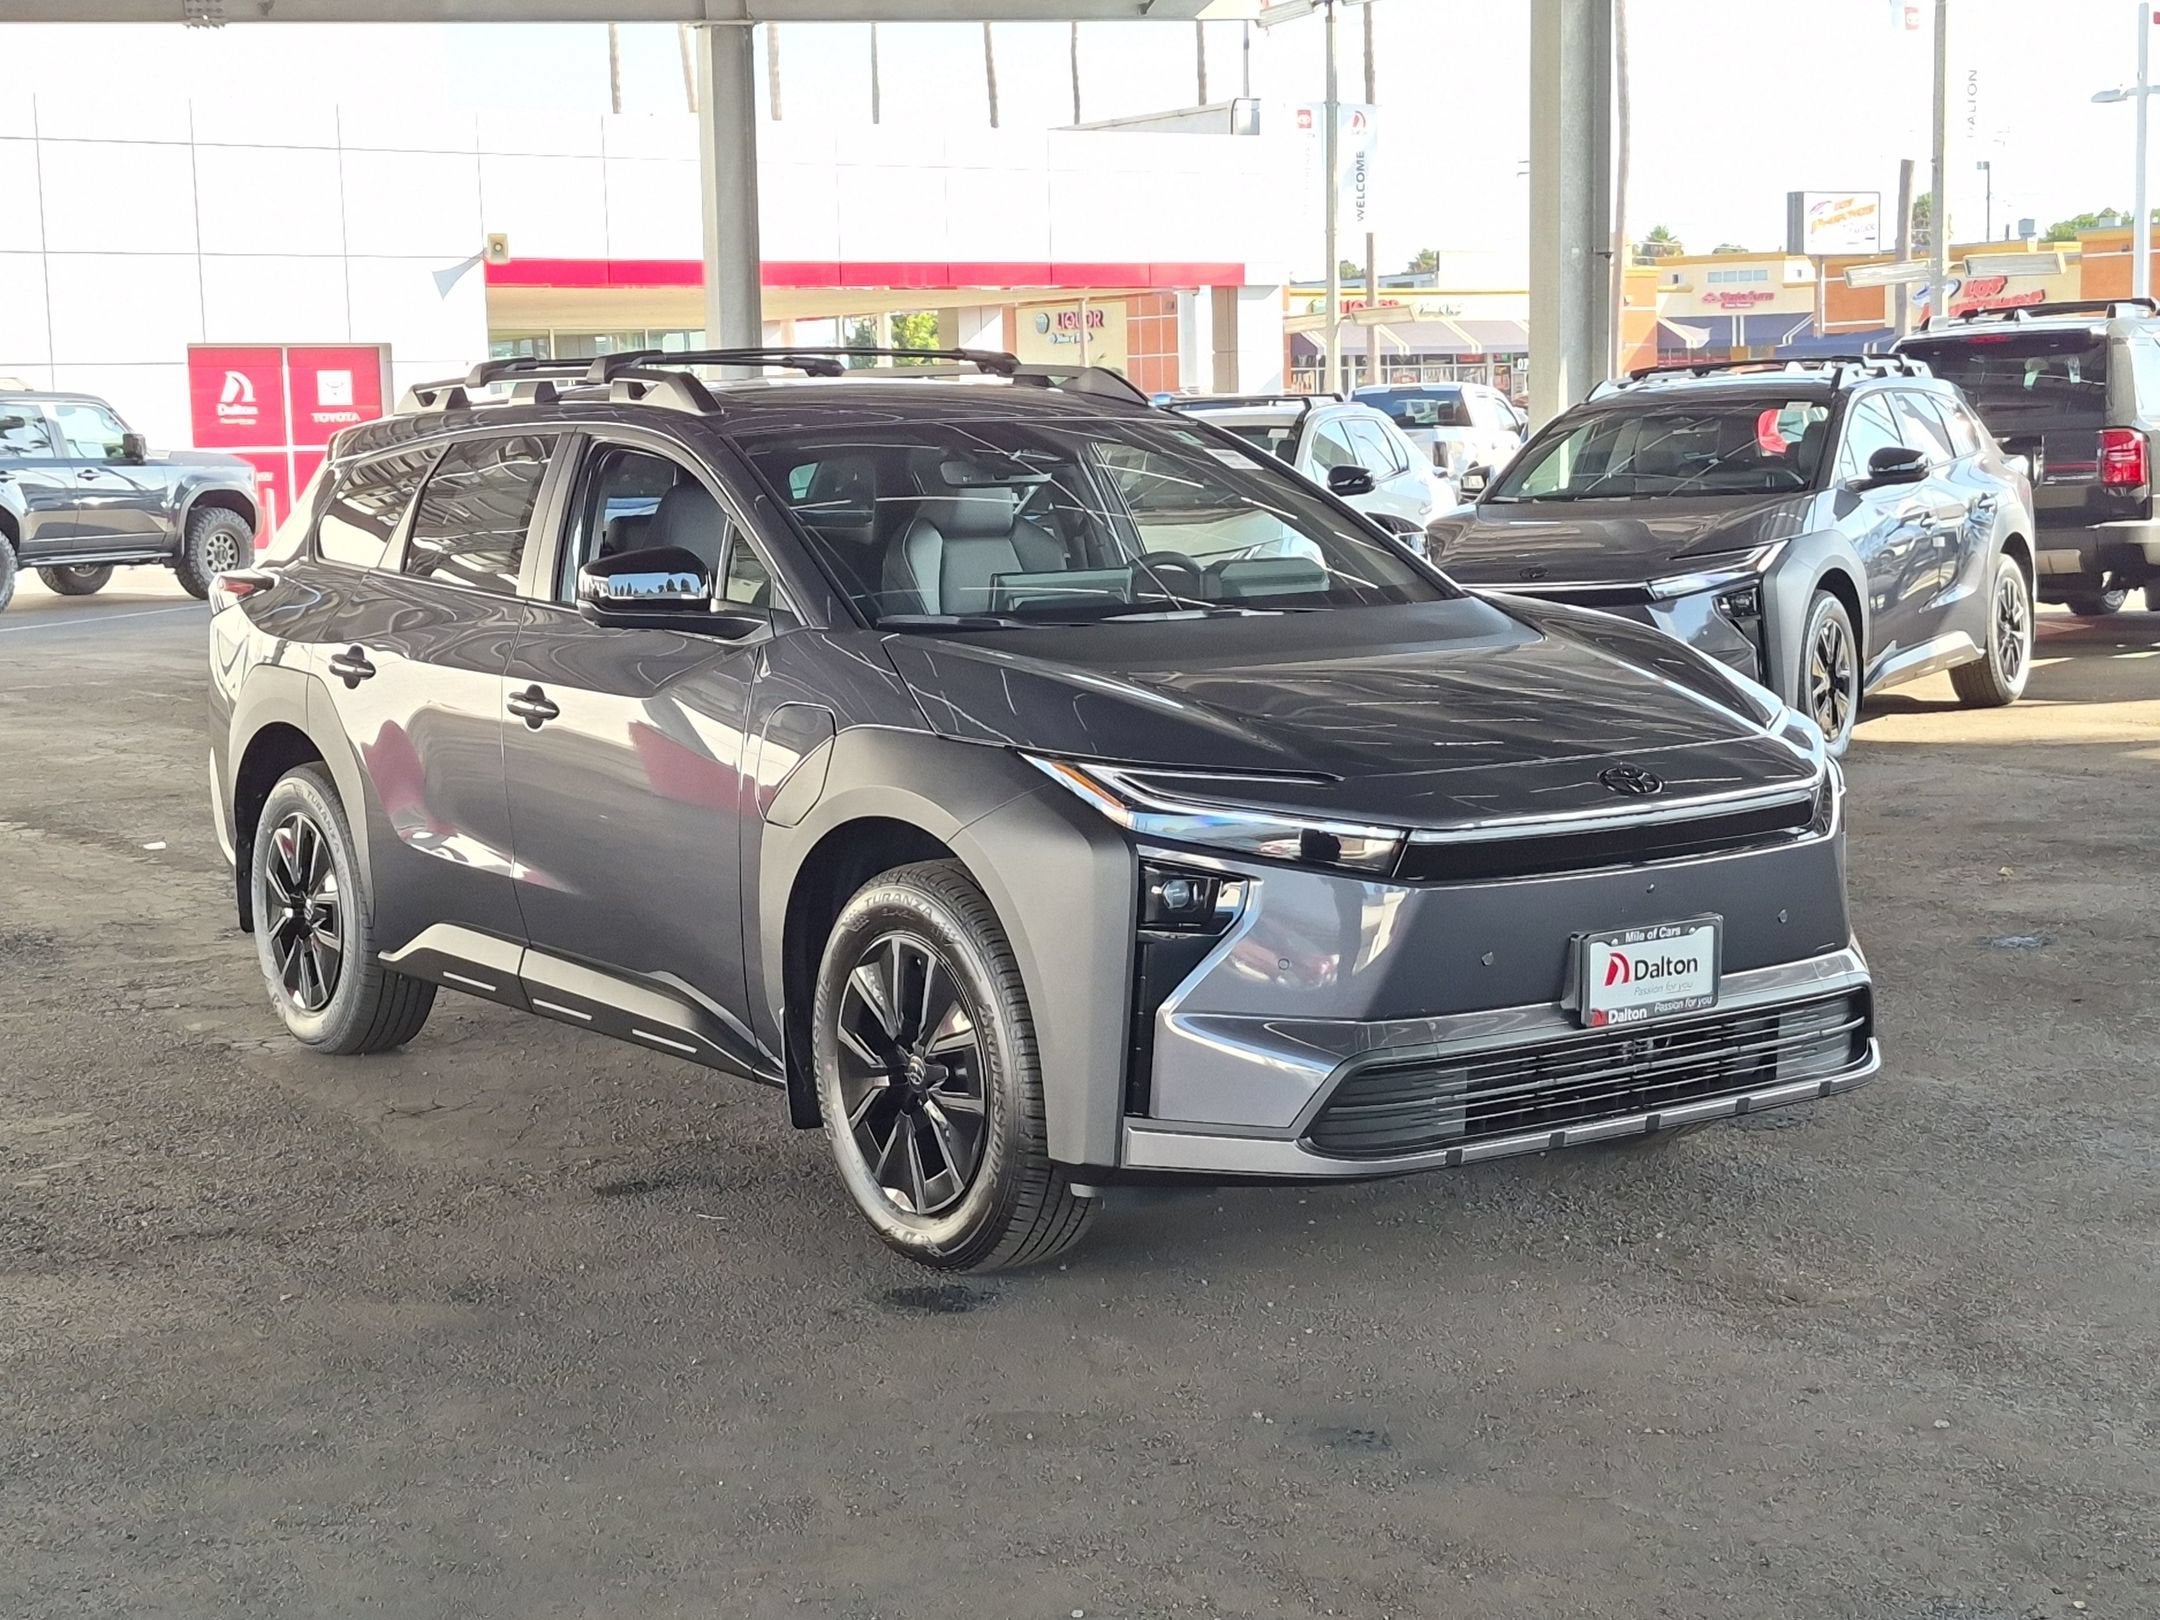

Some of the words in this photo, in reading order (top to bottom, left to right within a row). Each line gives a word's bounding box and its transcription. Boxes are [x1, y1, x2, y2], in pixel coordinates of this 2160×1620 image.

[1355, 150, 1366, 222] WELCOME
[310, 412, 361, 423] TOYOTA
[864, 892, 934, 919] TURANZA
[1625, 931, 1645, 943] Mile
[1647, 928, 1657, 939] of
[1659, 926, 1681, 939] Cars
[1634, 955, 1698, 981] Dalton
[1633, 984, 1663, 996] Passion
[1665, 981, 1677, 992] for
[1677, 980, 1693, 993] you
[1654, 1001, 1684, 1013] Passion
[1684, 996, 1697, 1008] for
[1697, 995, 1713, 1008] you
[1608, 1007, 1647, 1024] Dalton
